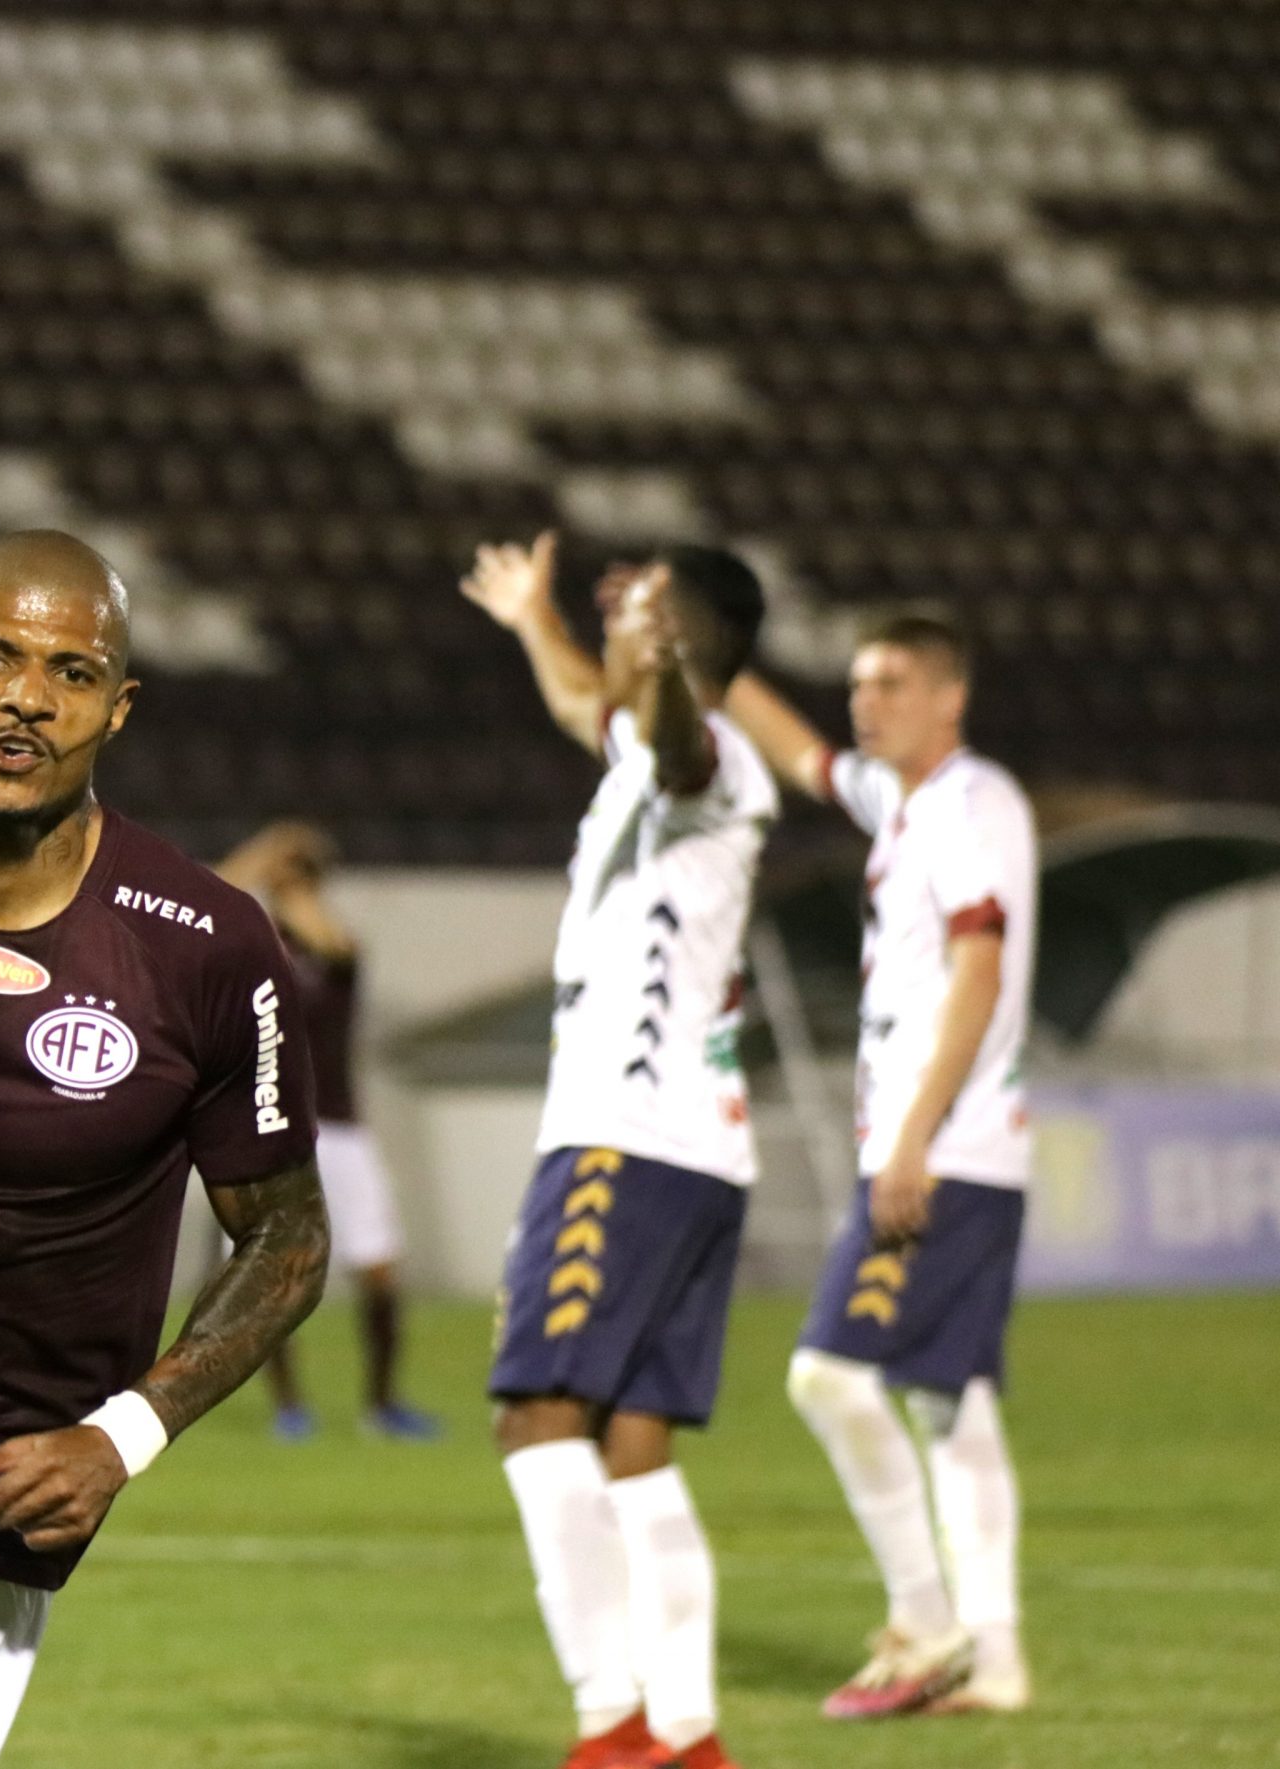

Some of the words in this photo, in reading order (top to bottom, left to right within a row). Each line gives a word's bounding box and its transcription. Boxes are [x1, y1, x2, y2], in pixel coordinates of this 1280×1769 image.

[114, 885, 214, 934] RIVERA
[41, 1021, 118, 1074] AFE
[252, 977, 289, 1134] Unimed
